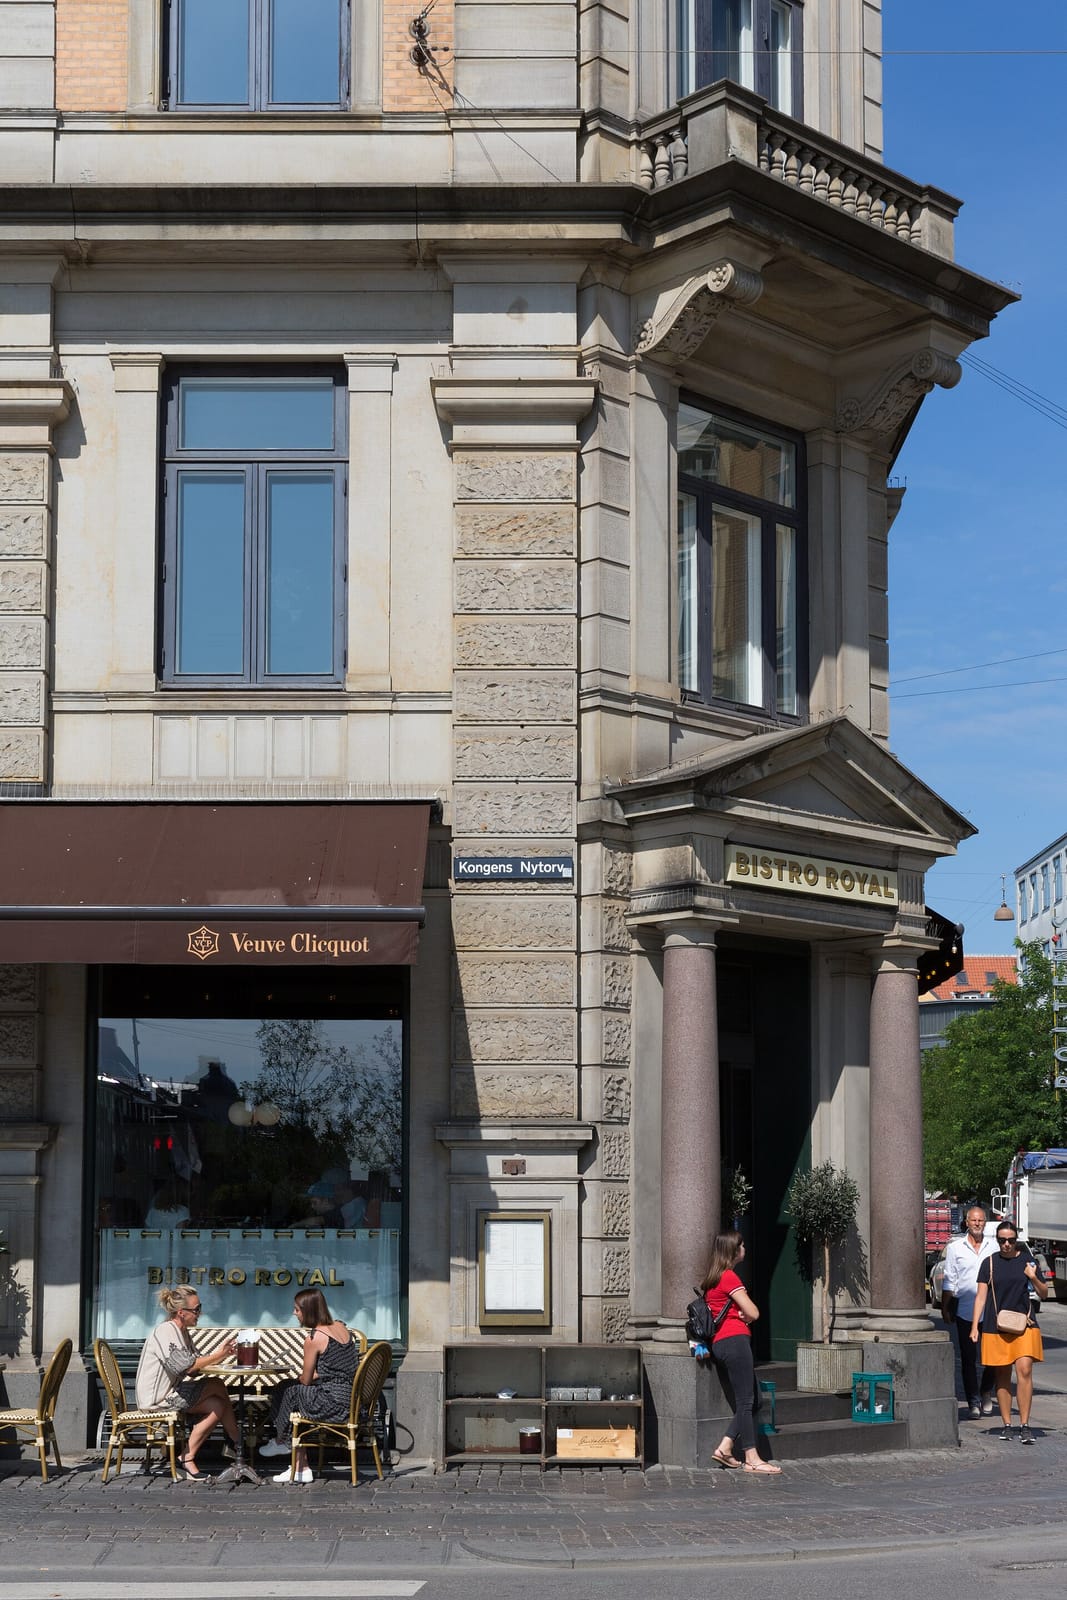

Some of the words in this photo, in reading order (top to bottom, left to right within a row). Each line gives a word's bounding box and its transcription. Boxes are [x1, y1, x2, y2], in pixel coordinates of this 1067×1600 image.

[459, 861, 512, 875] Kongens
[520, 861, 564, 875] Nytorv
[735, 851, 819, 886] BISTRO
[825, 866, 895, 899] ROYAL
[229, 932, 286, 953] Veuve
[290, 932, 370, 957] Clicquot
[147, 1266, 246, 1286] BISTRO
[254, 1266, 345, 1287] ROYAL
